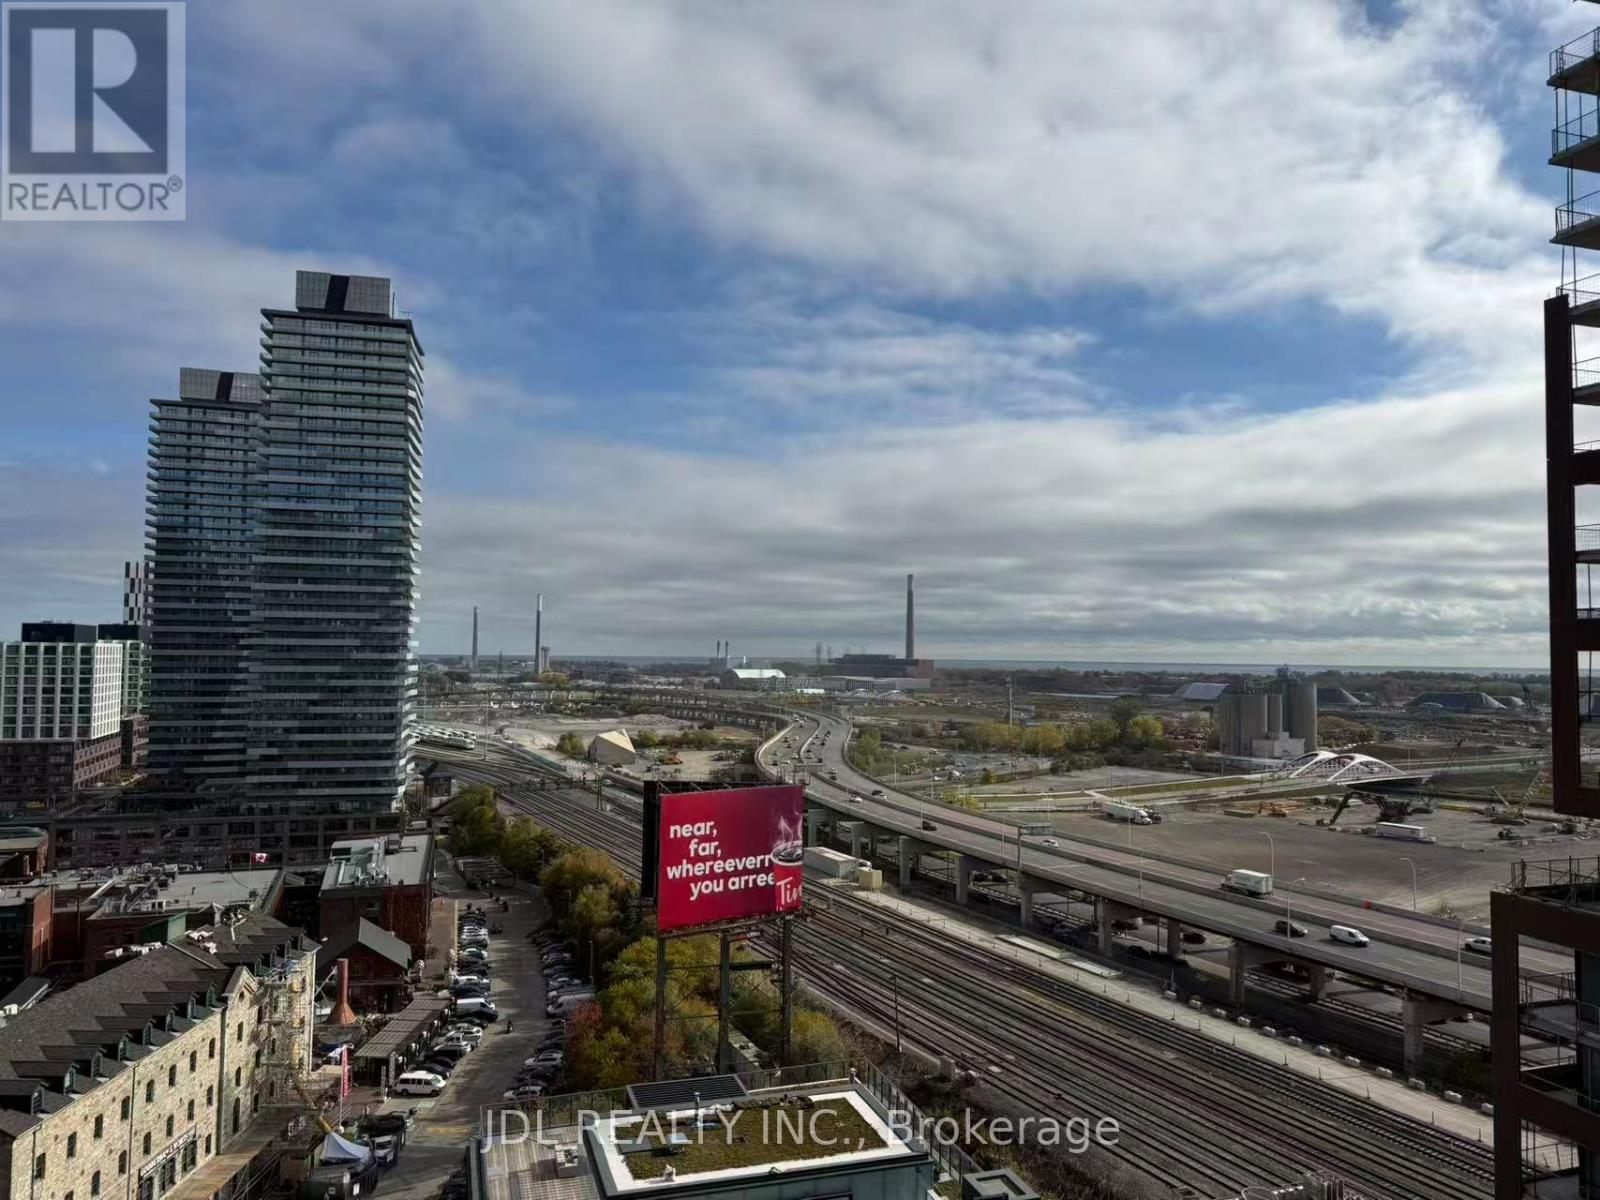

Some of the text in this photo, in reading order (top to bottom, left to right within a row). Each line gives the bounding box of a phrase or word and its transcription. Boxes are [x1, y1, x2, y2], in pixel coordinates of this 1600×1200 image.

[669, 821, 717, 839] near,
[689, 839, 721, 857] far,
[690, 872, 775, 901] you arree
